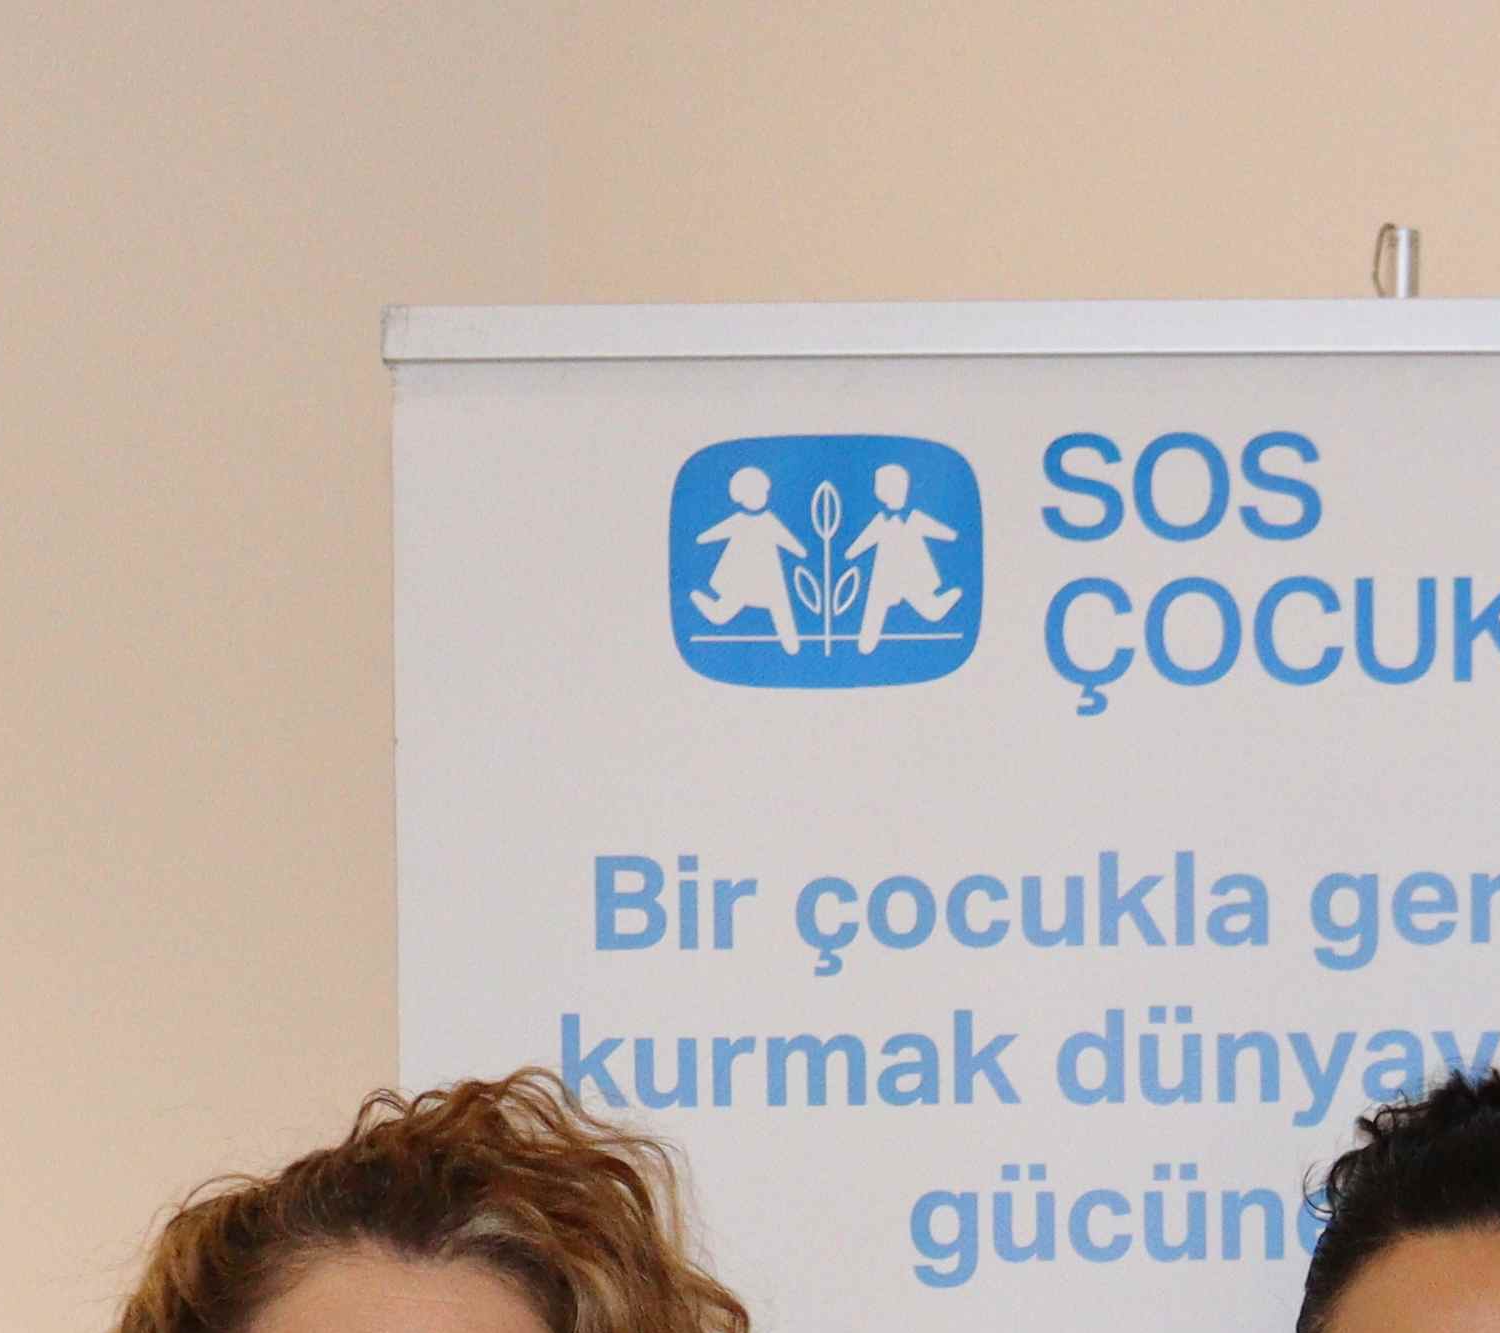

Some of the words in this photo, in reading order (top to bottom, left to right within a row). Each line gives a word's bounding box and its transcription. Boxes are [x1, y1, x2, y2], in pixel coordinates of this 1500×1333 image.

[1041, 430, 1324, 544] SOS
[594, 854, 758, 952] Bir
[796, 850, 1269, 978] çocukla
[560, 1008, 1020, 1110] kurmak
